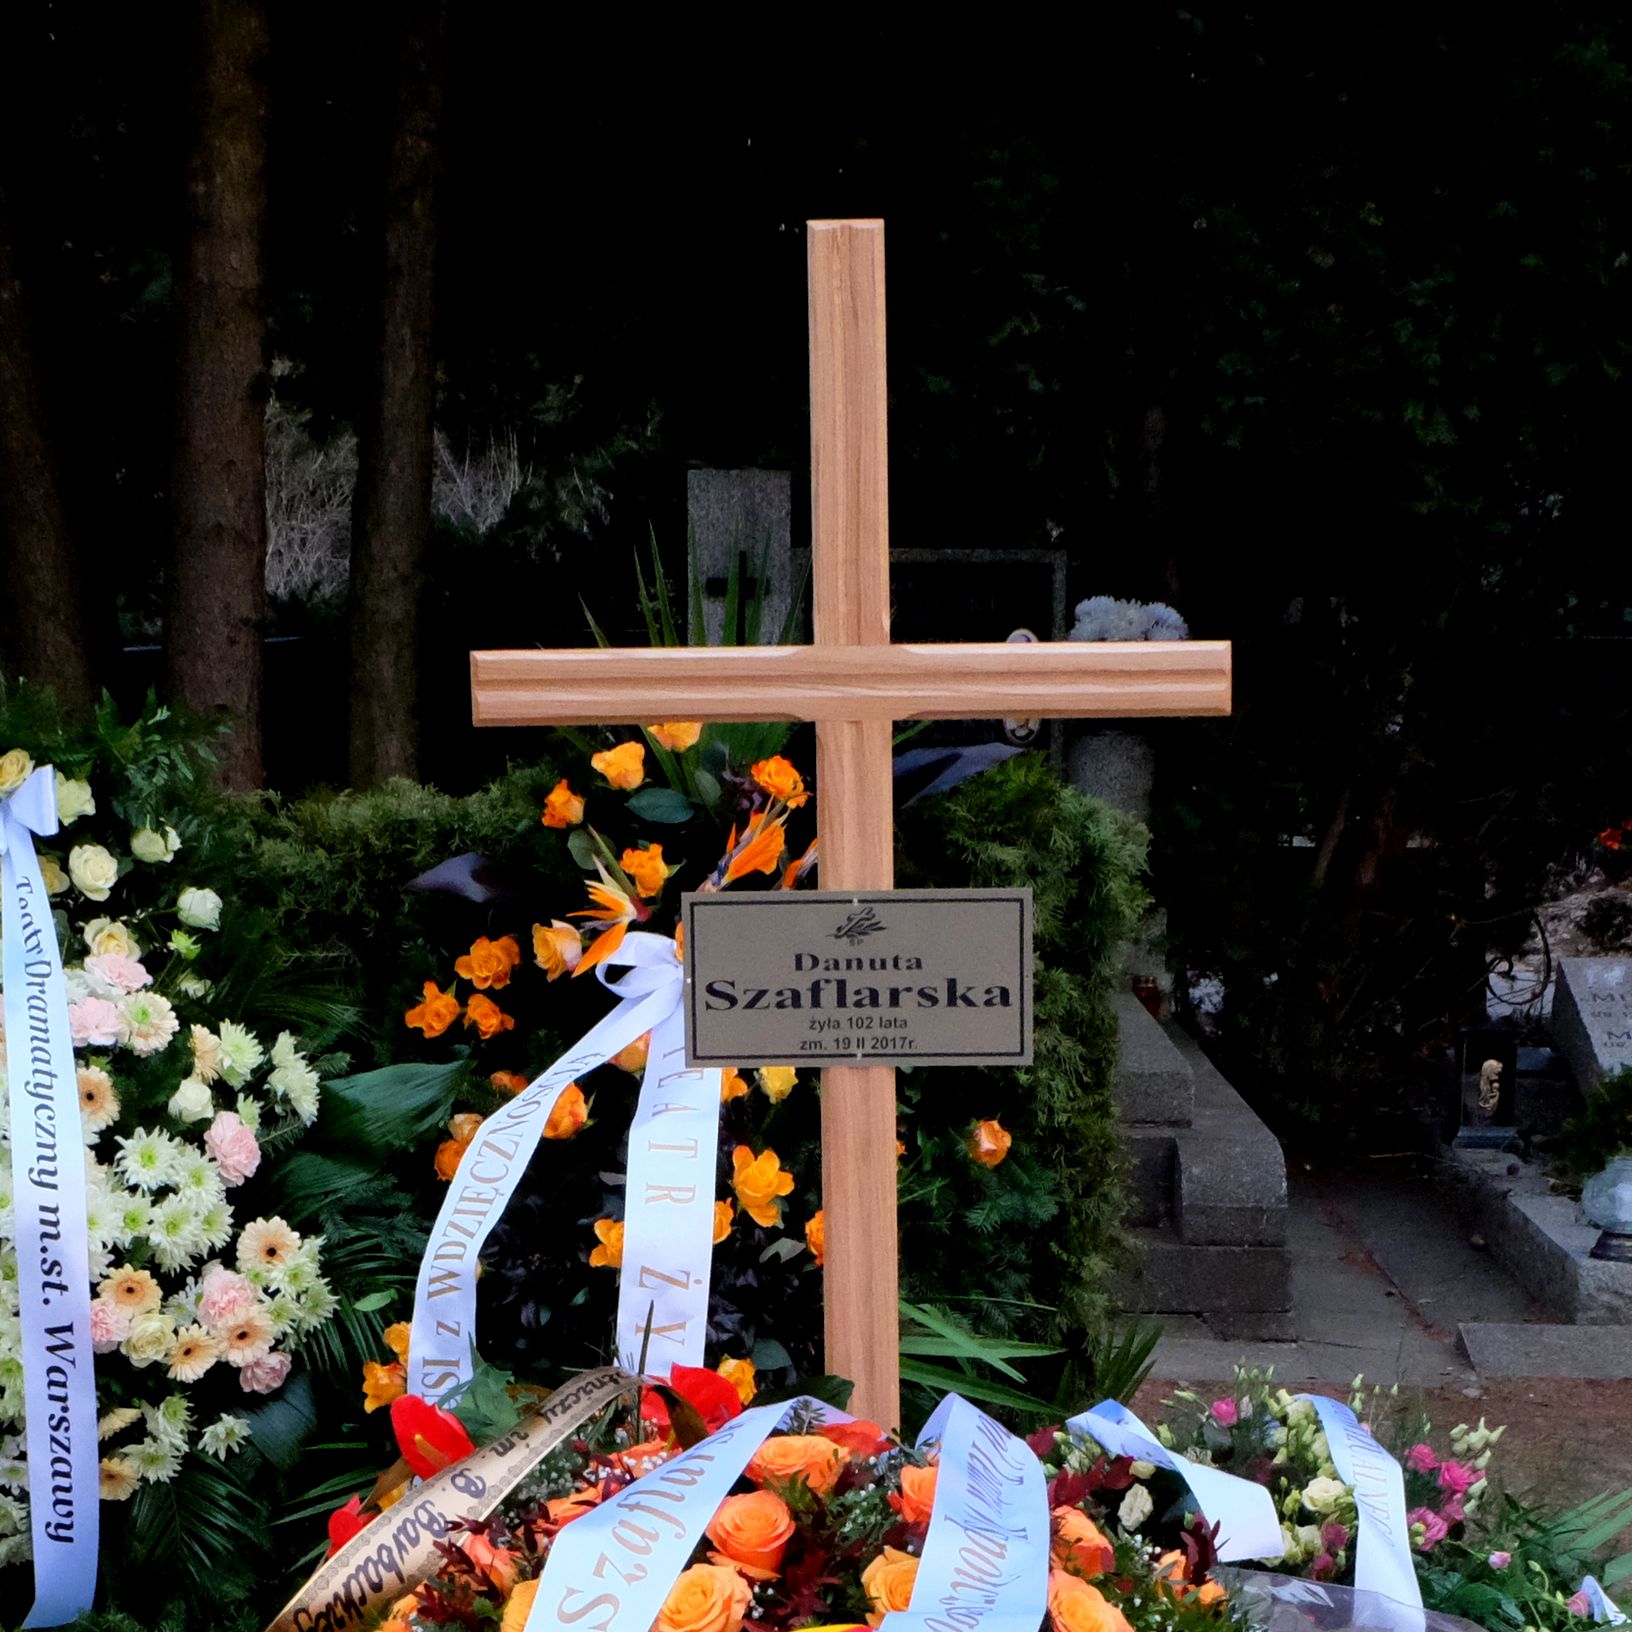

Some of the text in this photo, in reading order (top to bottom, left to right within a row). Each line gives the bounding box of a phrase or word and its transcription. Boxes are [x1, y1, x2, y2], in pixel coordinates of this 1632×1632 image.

[794, 952, 924, 972] Danuta
[705, 978, 1013, 1011] Szaflarska
[809, 1016, 908, 1033] żyła 102 lata
[800, 1038, 828, 1050] zm.
[834, 1037, 850, 1050] 19
[856, 1037, 866, 1050] II
[20, 957, 61, 1193] Dramatyczny
[37, 1201, 71, 1307] m.st.
[44, 1321, 77, 1546] Warszawy
